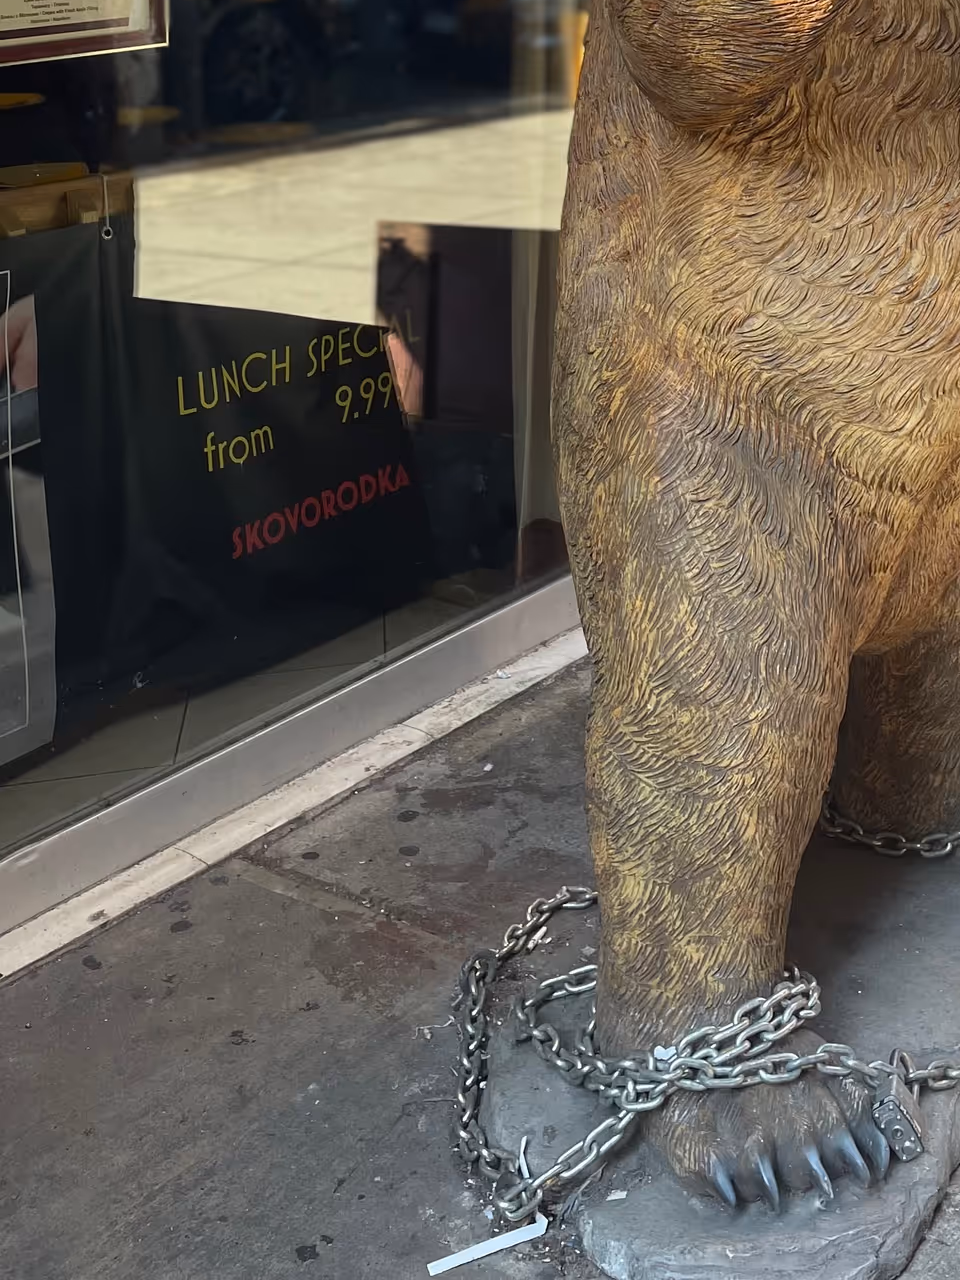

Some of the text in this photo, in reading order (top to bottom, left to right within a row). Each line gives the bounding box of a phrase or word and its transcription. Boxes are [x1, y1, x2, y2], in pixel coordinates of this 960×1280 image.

[177, 345, 291, 416] LUNCH
[335, 371, 394, 423] 9.99
[204, 425, 275, 472] from
[232, 463, 411, 560] SKOVORODKA
